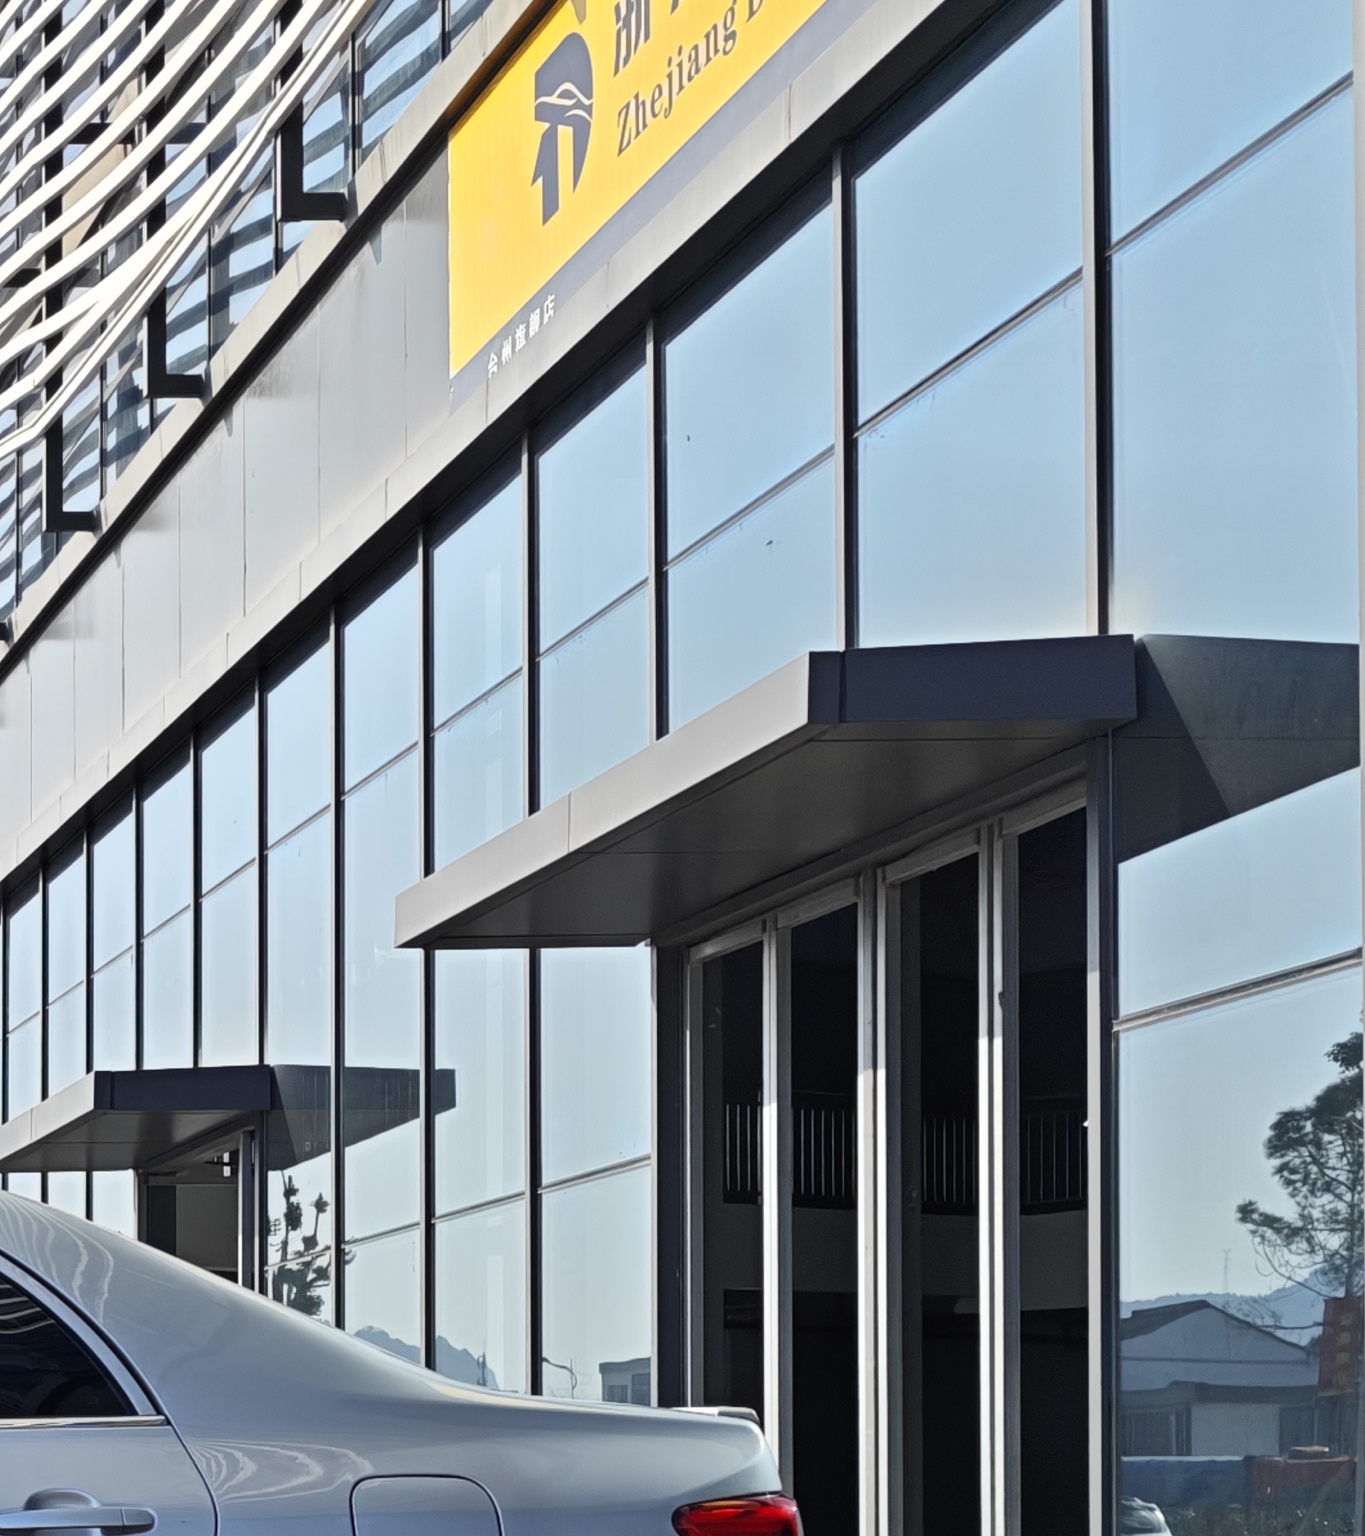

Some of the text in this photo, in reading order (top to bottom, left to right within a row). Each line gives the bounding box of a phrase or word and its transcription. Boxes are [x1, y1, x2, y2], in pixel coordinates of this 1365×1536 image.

[616, 0, 738, 158] Zhejiang
[487, 293, 556, 379] 台州旗舰店
